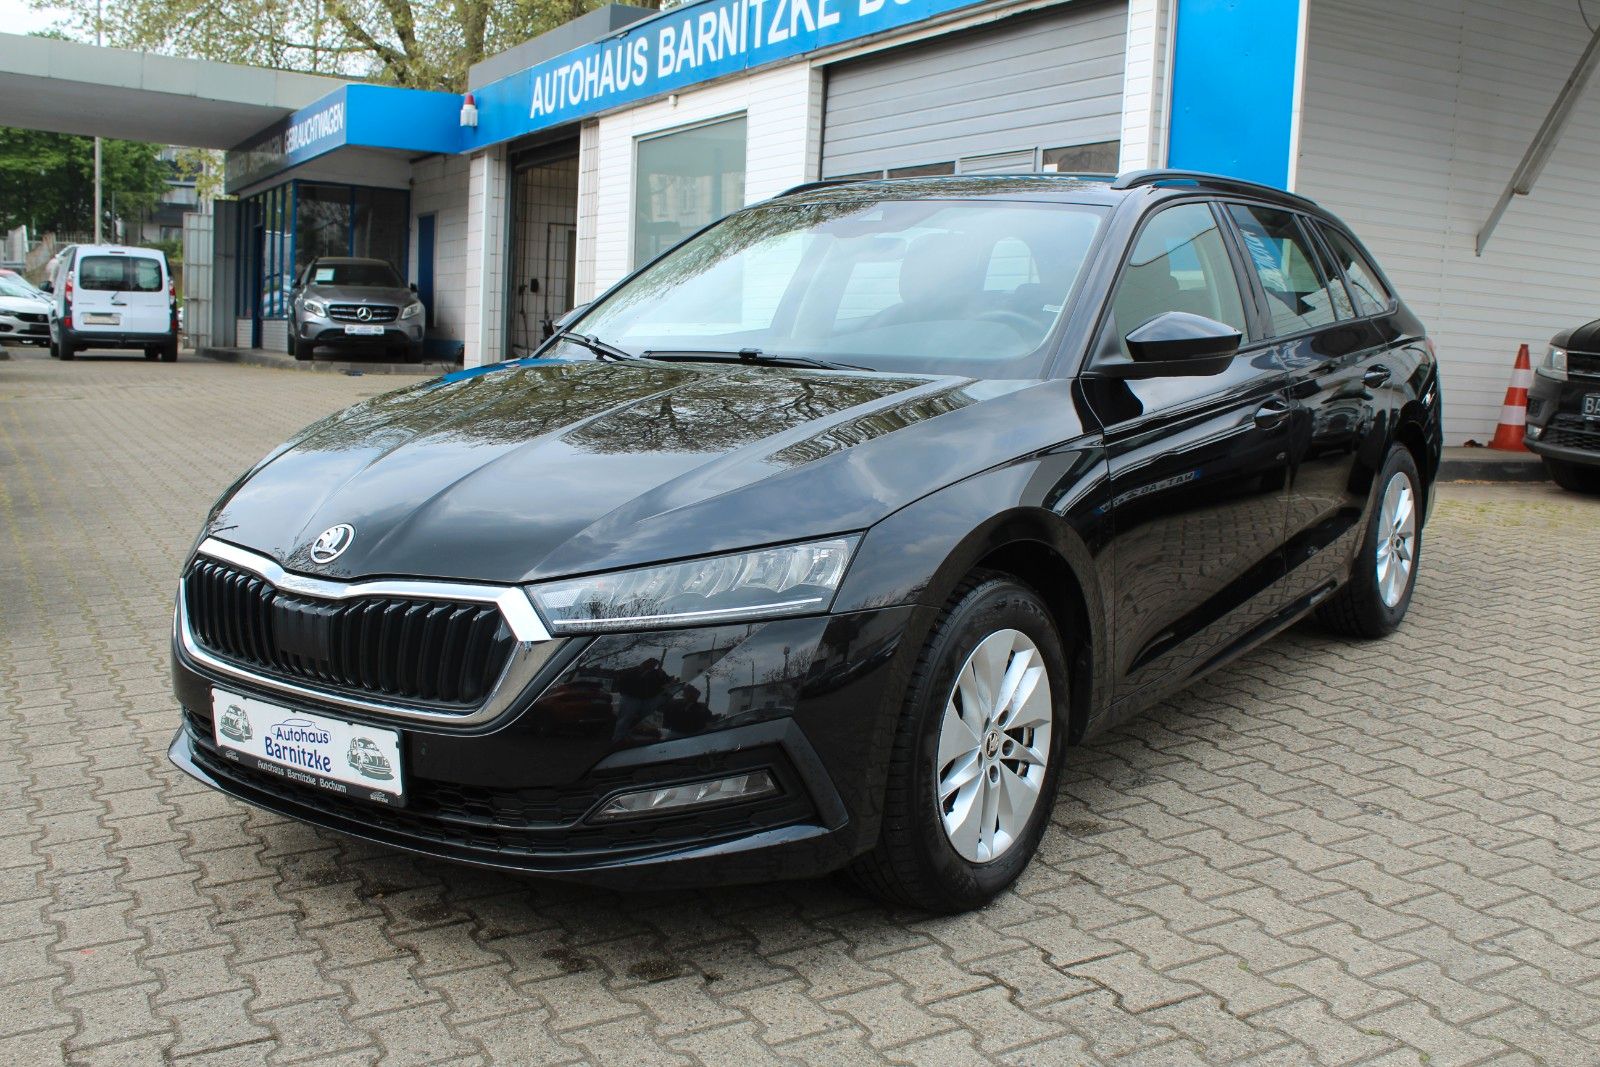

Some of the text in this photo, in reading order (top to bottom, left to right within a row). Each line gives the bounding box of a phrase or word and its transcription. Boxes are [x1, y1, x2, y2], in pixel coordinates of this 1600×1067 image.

[530, 36, 648, 119] AUTOHAUS
[275, 727, 329, 744] Autohaus
[264, 736, 332, 773] Barnitzke
[257, 760, 347, 794] Autohaus Barnitzke Bochum
